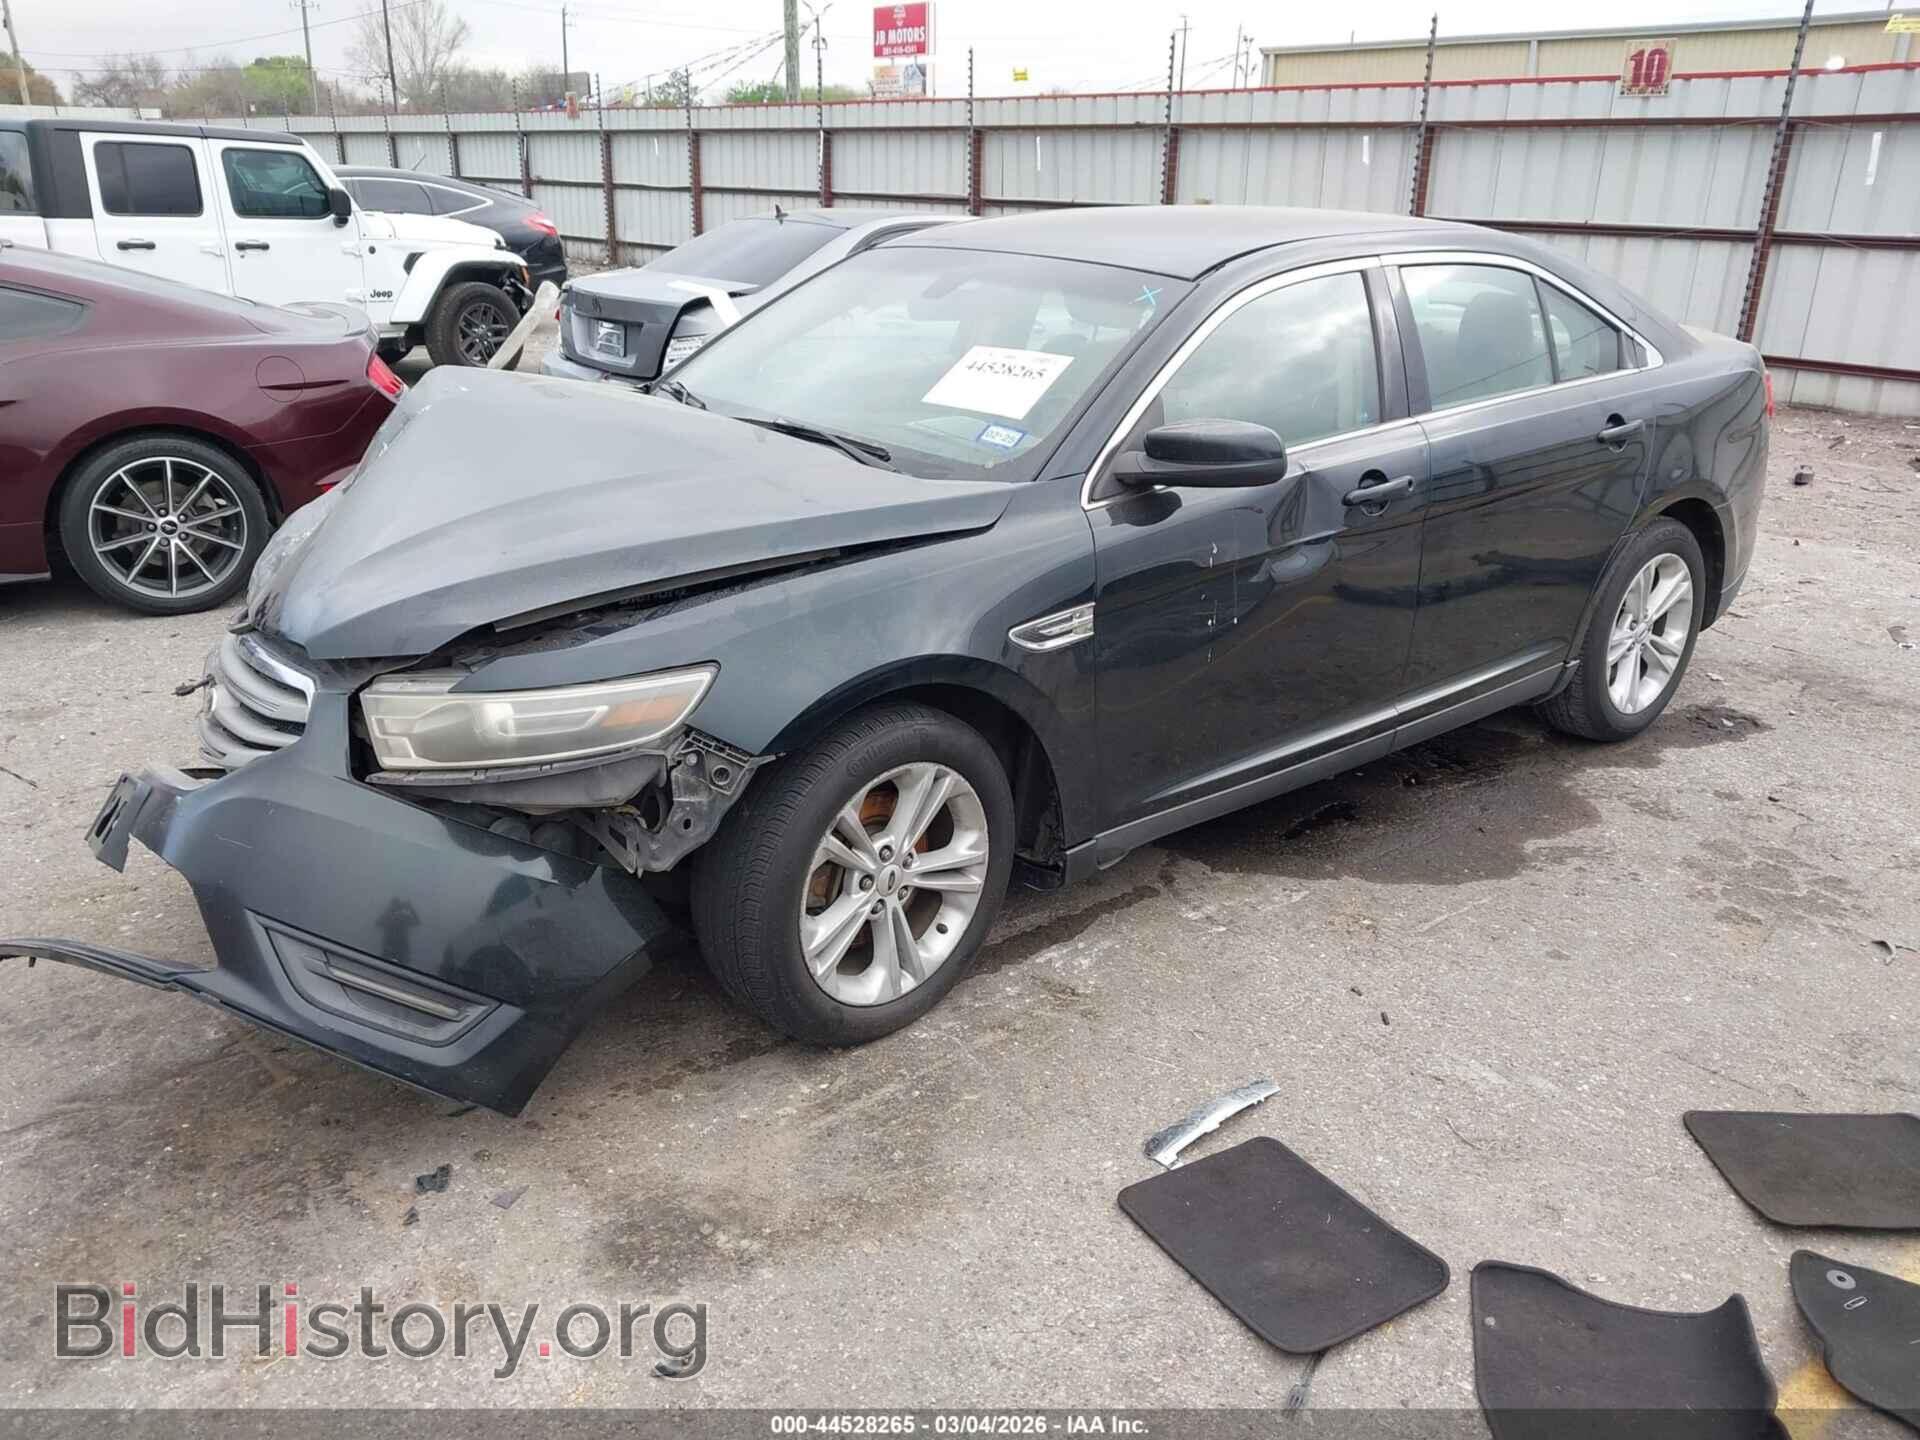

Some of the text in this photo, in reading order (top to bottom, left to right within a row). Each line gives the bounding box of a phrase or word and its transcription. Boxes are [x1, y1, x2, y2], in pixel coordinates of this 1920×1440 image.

[875, 26, 925, 46] JB MOTORS
[1630, 48, 1668, 87] 10
[370, 289, 392, 298] Jeep
[966, 360, 1047, 379] 44528265
